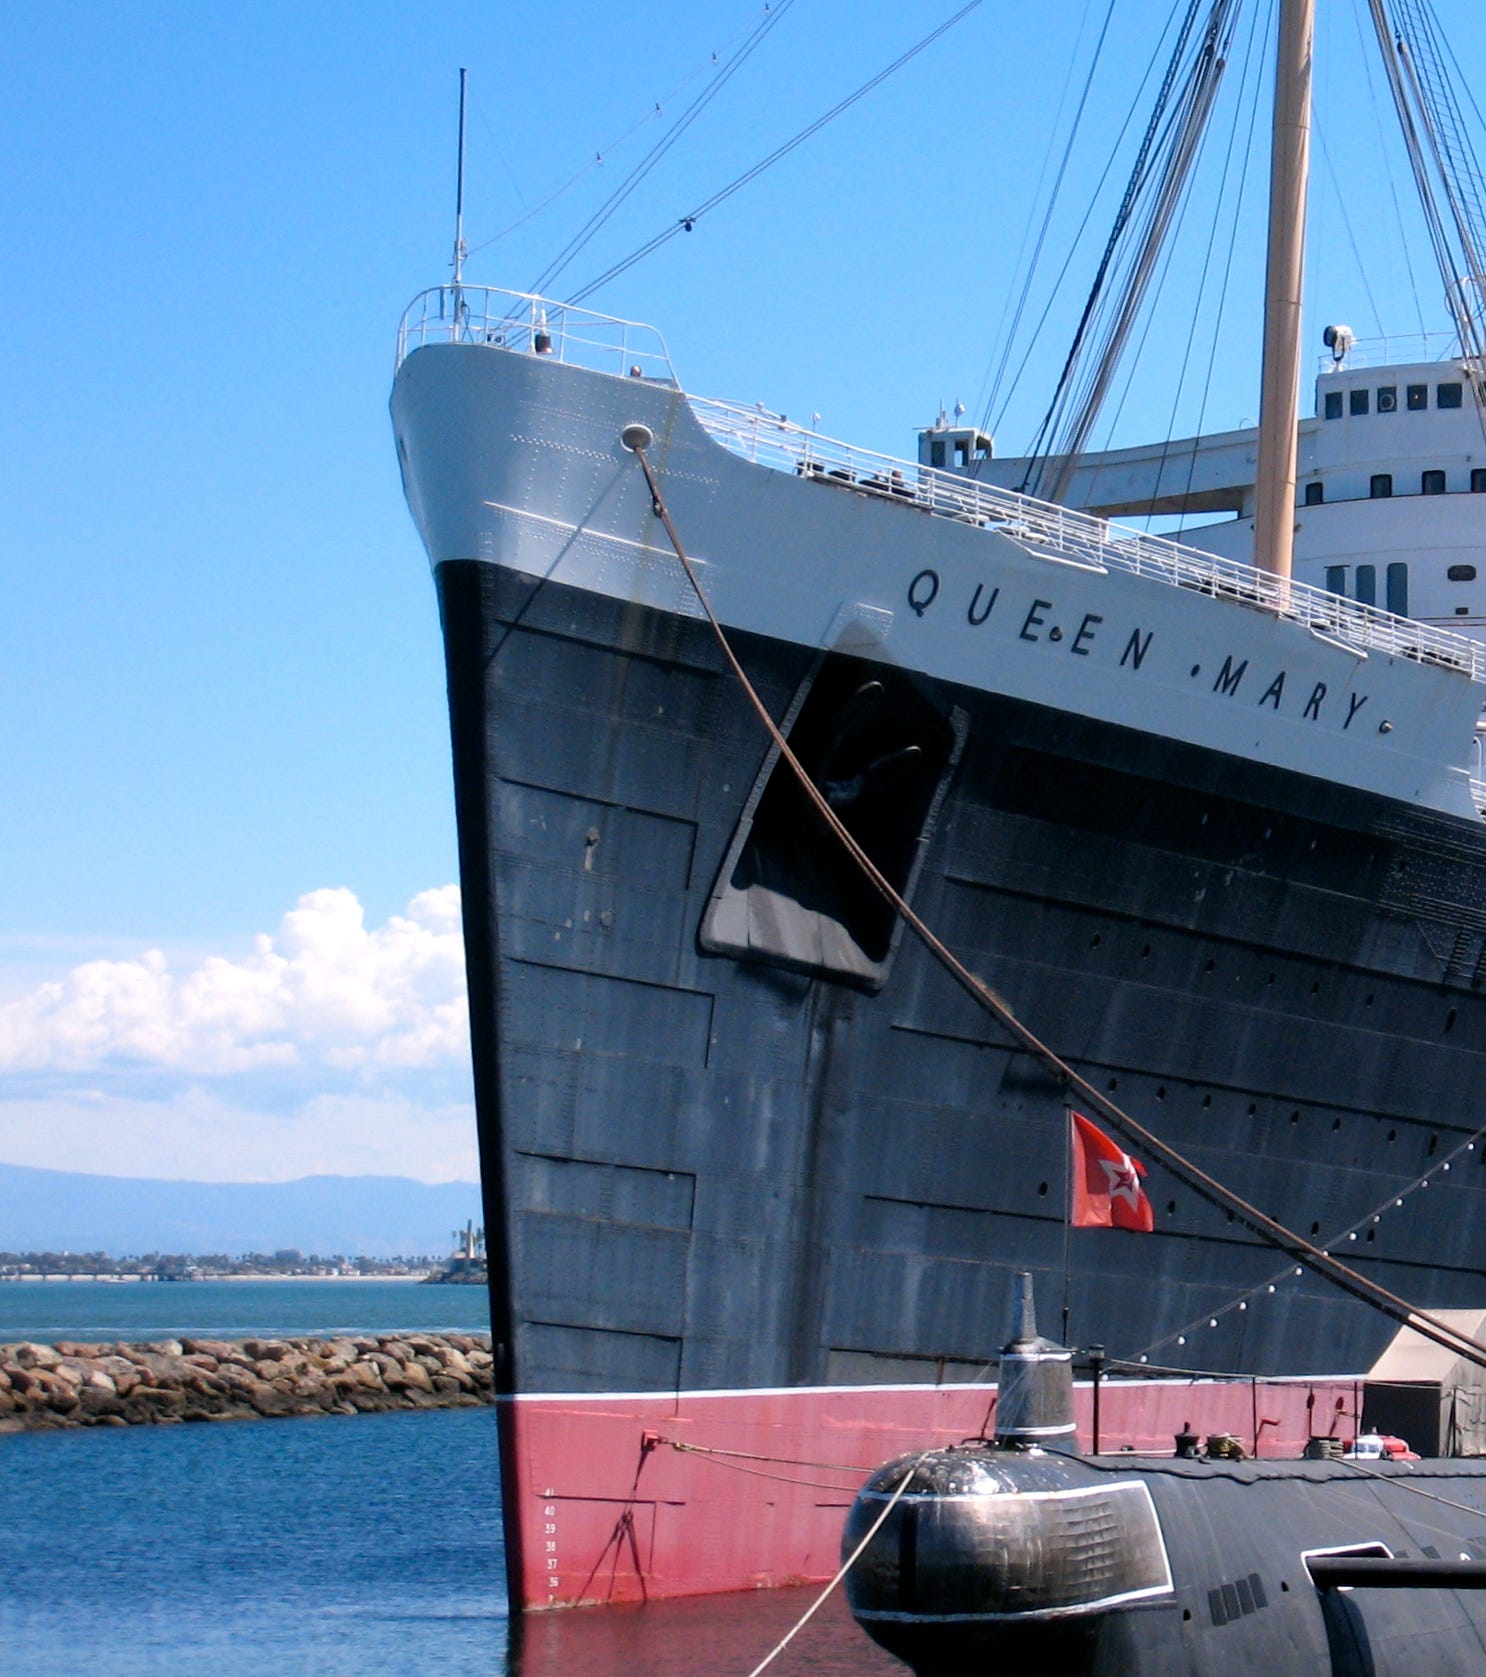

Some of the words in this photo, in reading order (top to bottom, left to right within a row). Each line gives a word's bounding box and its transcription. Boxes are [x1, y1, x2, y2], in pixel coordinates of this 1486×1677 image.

[907, 569, 1154, 671] QUEEN
[1212, 654, 1369, 731] MARY
[545, 1523, 556, 1534] 39
[546, 1541, 556, 1552] 38
[547, 1558, 558, 1570] 37
